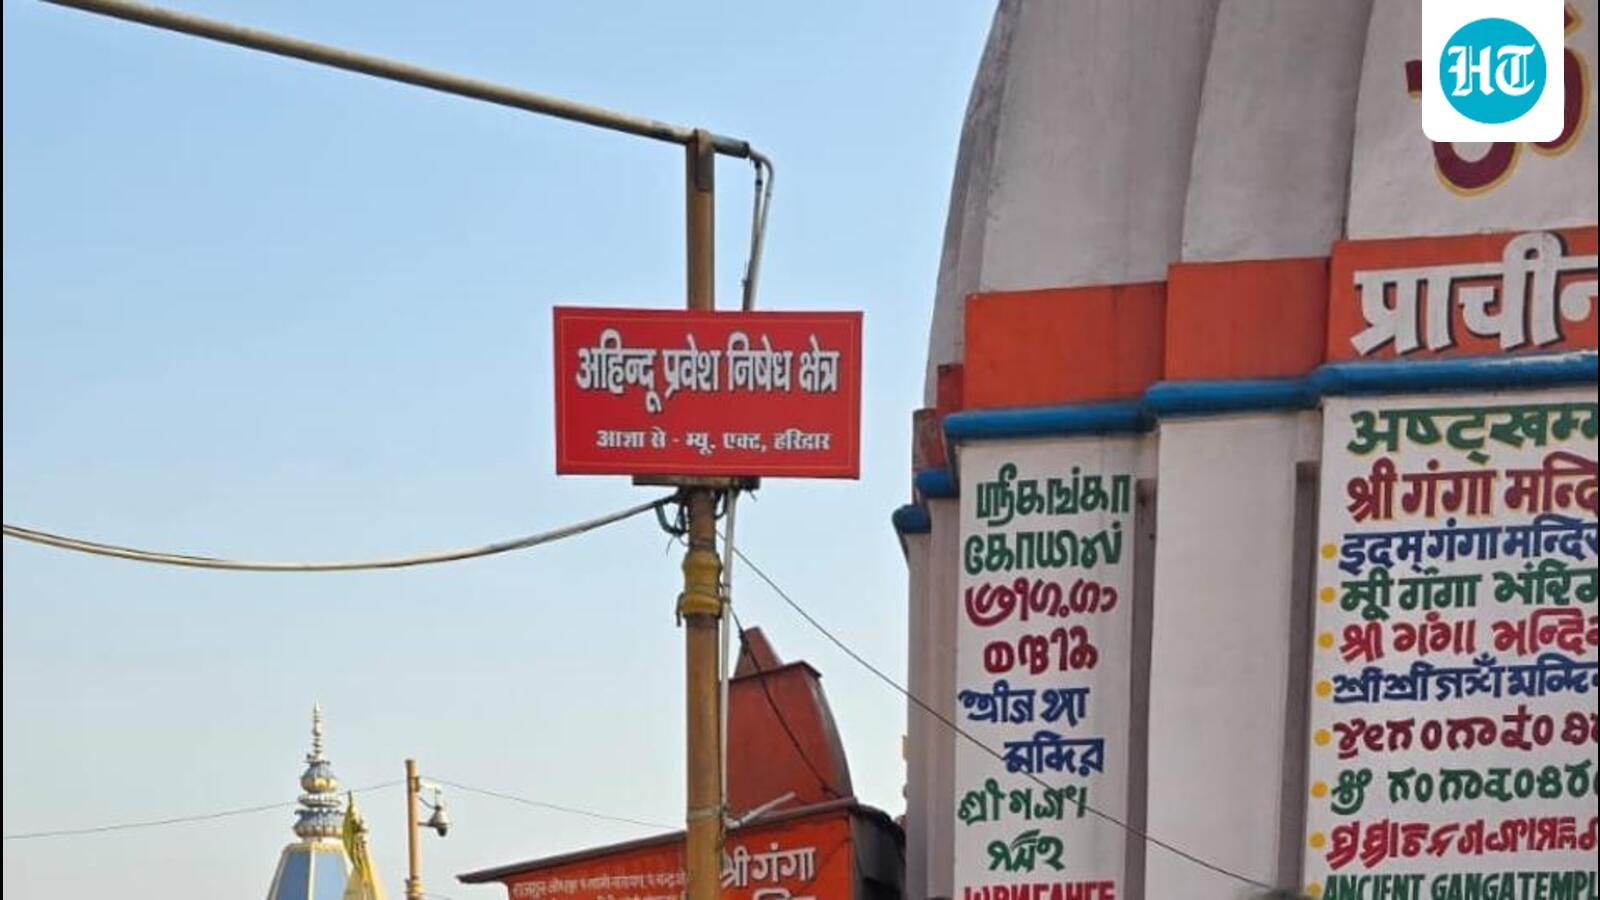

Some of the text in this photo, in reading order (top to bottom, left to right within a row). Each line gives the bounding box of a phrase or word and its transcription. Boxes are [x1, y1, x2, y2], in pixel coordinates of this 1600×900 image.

[576, 328, 840, 412] अहिन्दू प्रवेश निषेध क्षेत्र
[650, 426, 666, 448] से
[1347, 457, 1398, 522] श्री
[1401, 458, 1497, 517] गंगा
[1427, 517, 1502, 563] गंगा
[752, 842, 816, 883] गंगा
[1321, 873, 1425, 900] ANCIENT
